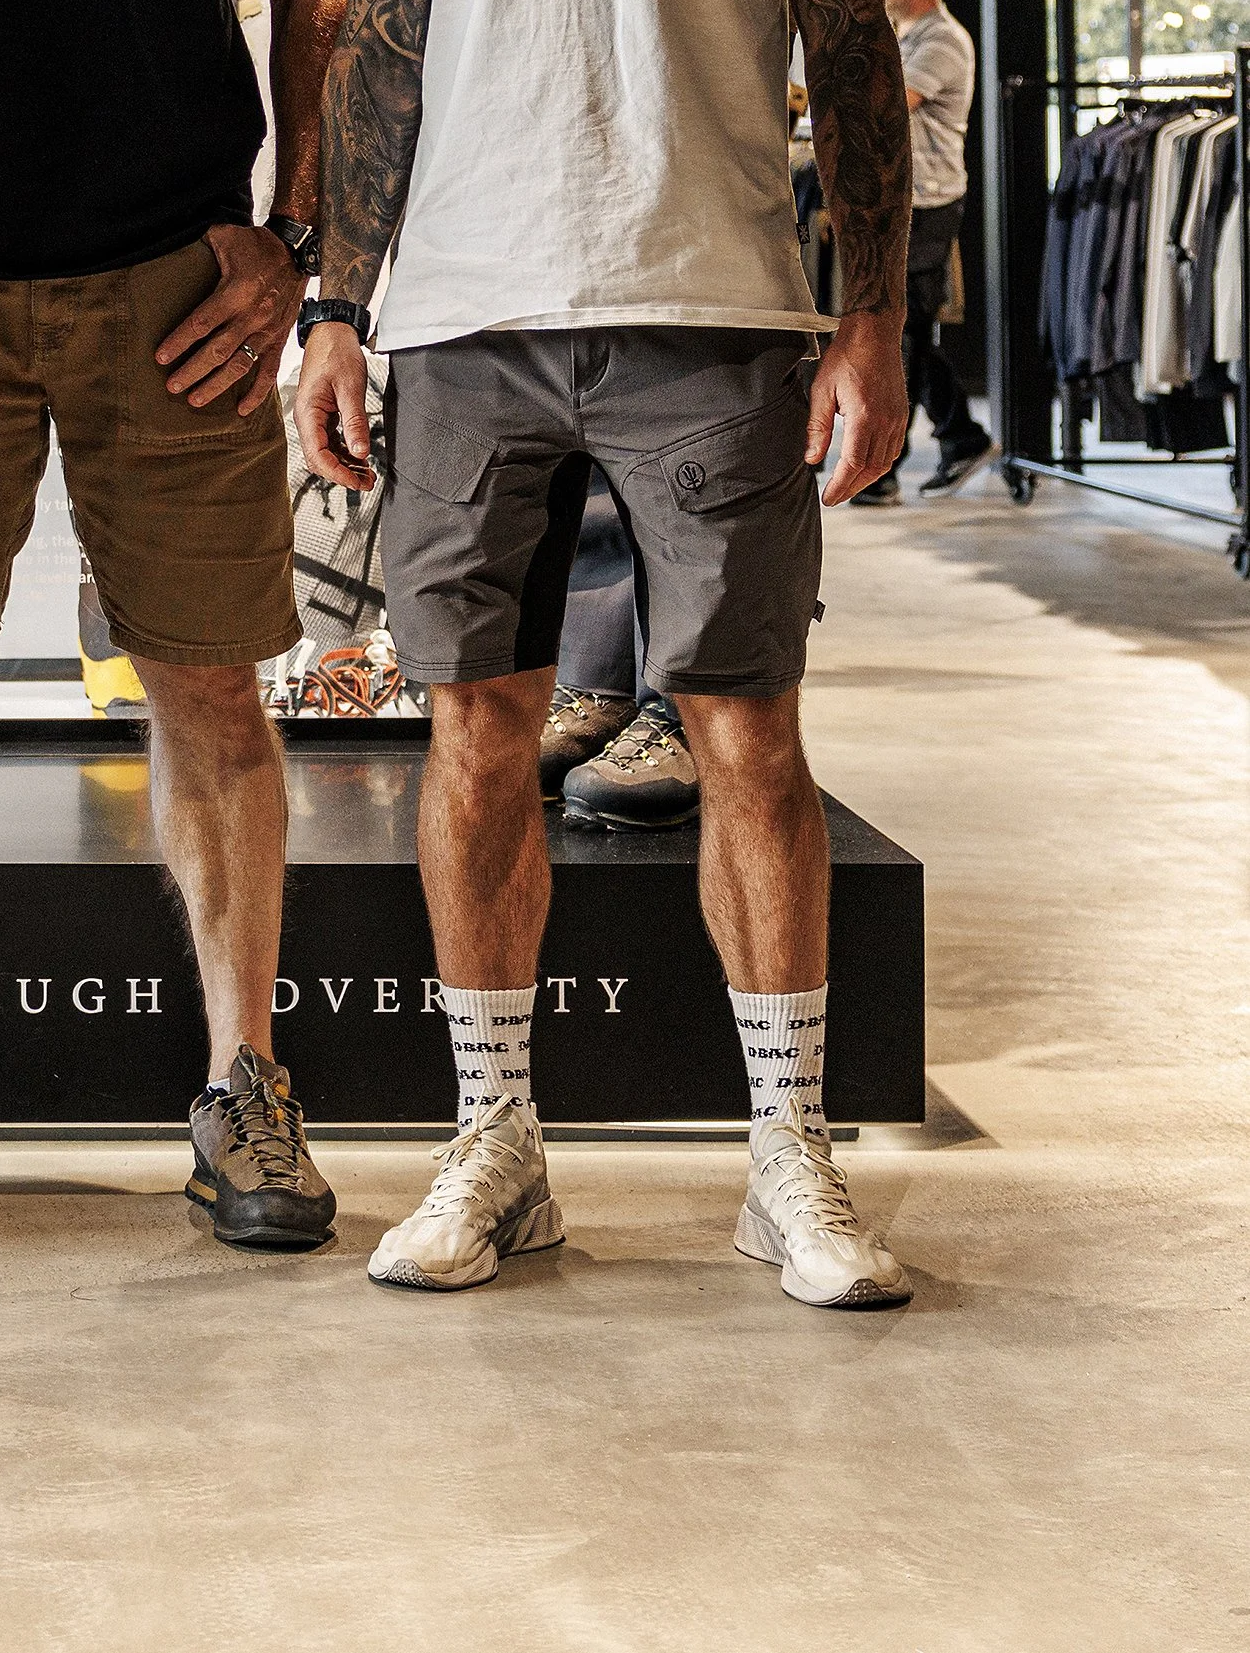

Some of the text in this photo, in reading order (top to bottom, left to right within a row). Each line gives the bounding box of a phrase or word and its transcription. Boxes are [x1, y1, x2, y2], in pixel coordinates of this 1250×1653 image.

[270, 977, 629, 1014] DVERTY
[491, 1012, 533, 1026] DBA
[747, 1045, 801, 1059] DBAC
[776, 1075, 823, 1089] DBA
